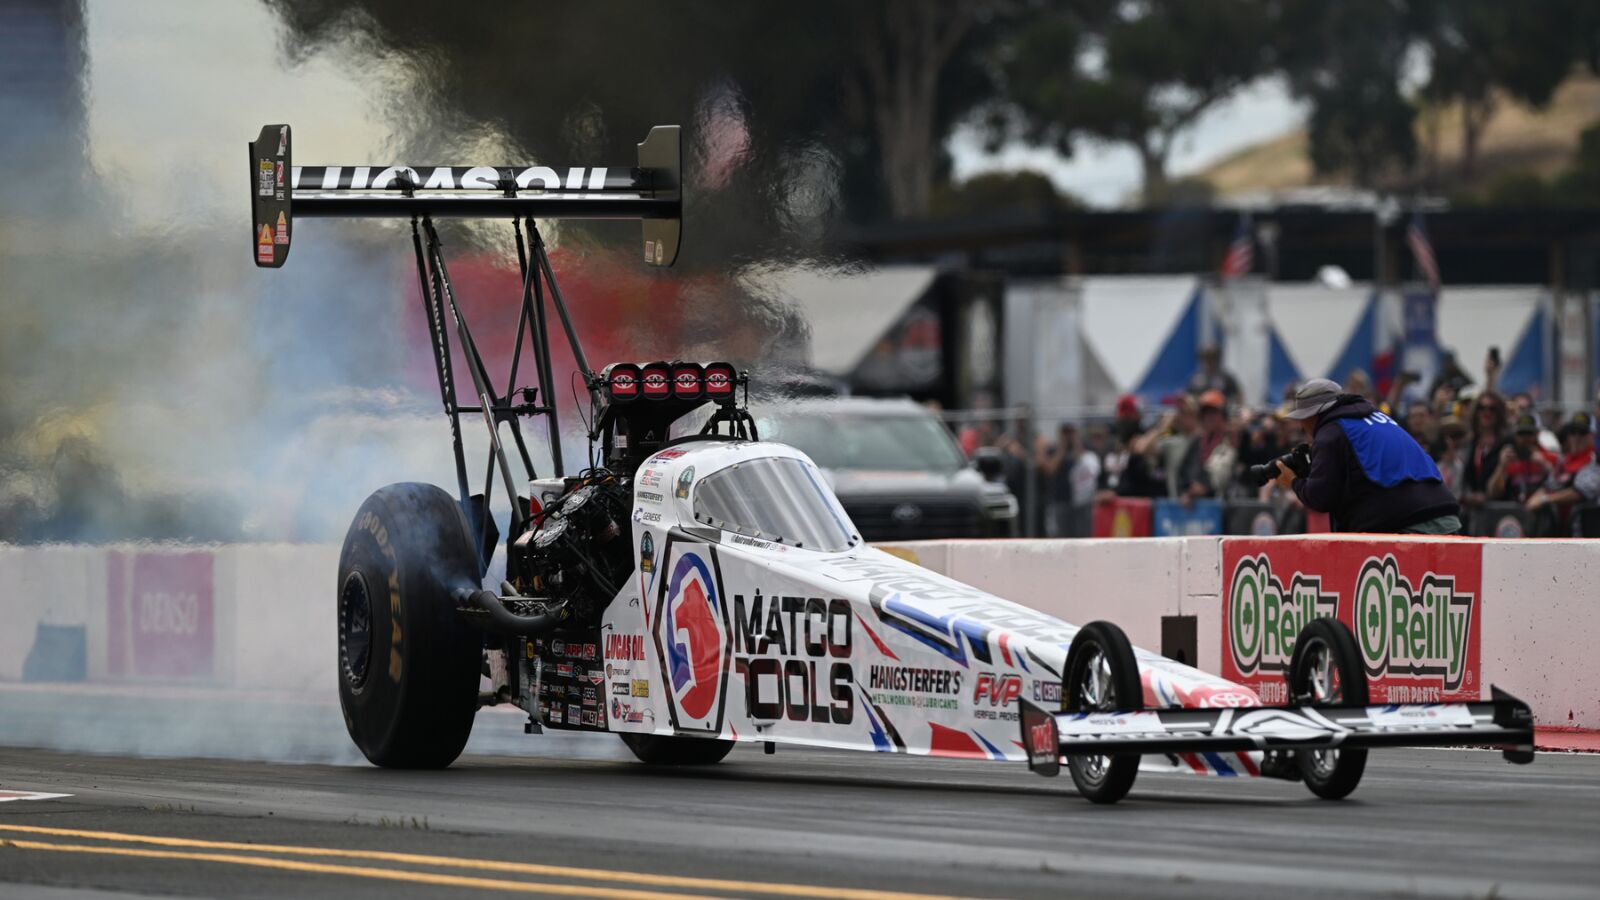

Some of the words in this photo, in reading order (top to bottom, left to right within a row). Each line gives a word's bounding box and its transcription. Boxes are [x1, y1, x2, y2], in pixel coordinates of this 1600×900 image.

[141, 591, 198, 635] DENSO
[734, 594, 853, 659] MATCO
[1235, 572, 1331, 658] O'Rei
[1360, 572, 1465, 675] O'Reilly
[605, 634, 631, 661] LUCAS
[632, 634, 645, 660] OIL
[735, 656, 854, 726] TOOLS
[870, 665, 961, 695] HANGSTERFER'S
[973, 671, 1023, 707] FVP
[1043, 683, 1062, 700] CENT
[1387, 685, 1409, 704] AUTO
[1410, 686, 1440, 704] PARTS
[923, 698, 959, 710] LUBRICANTS
[999, 711, 1020, 722] PROVE
